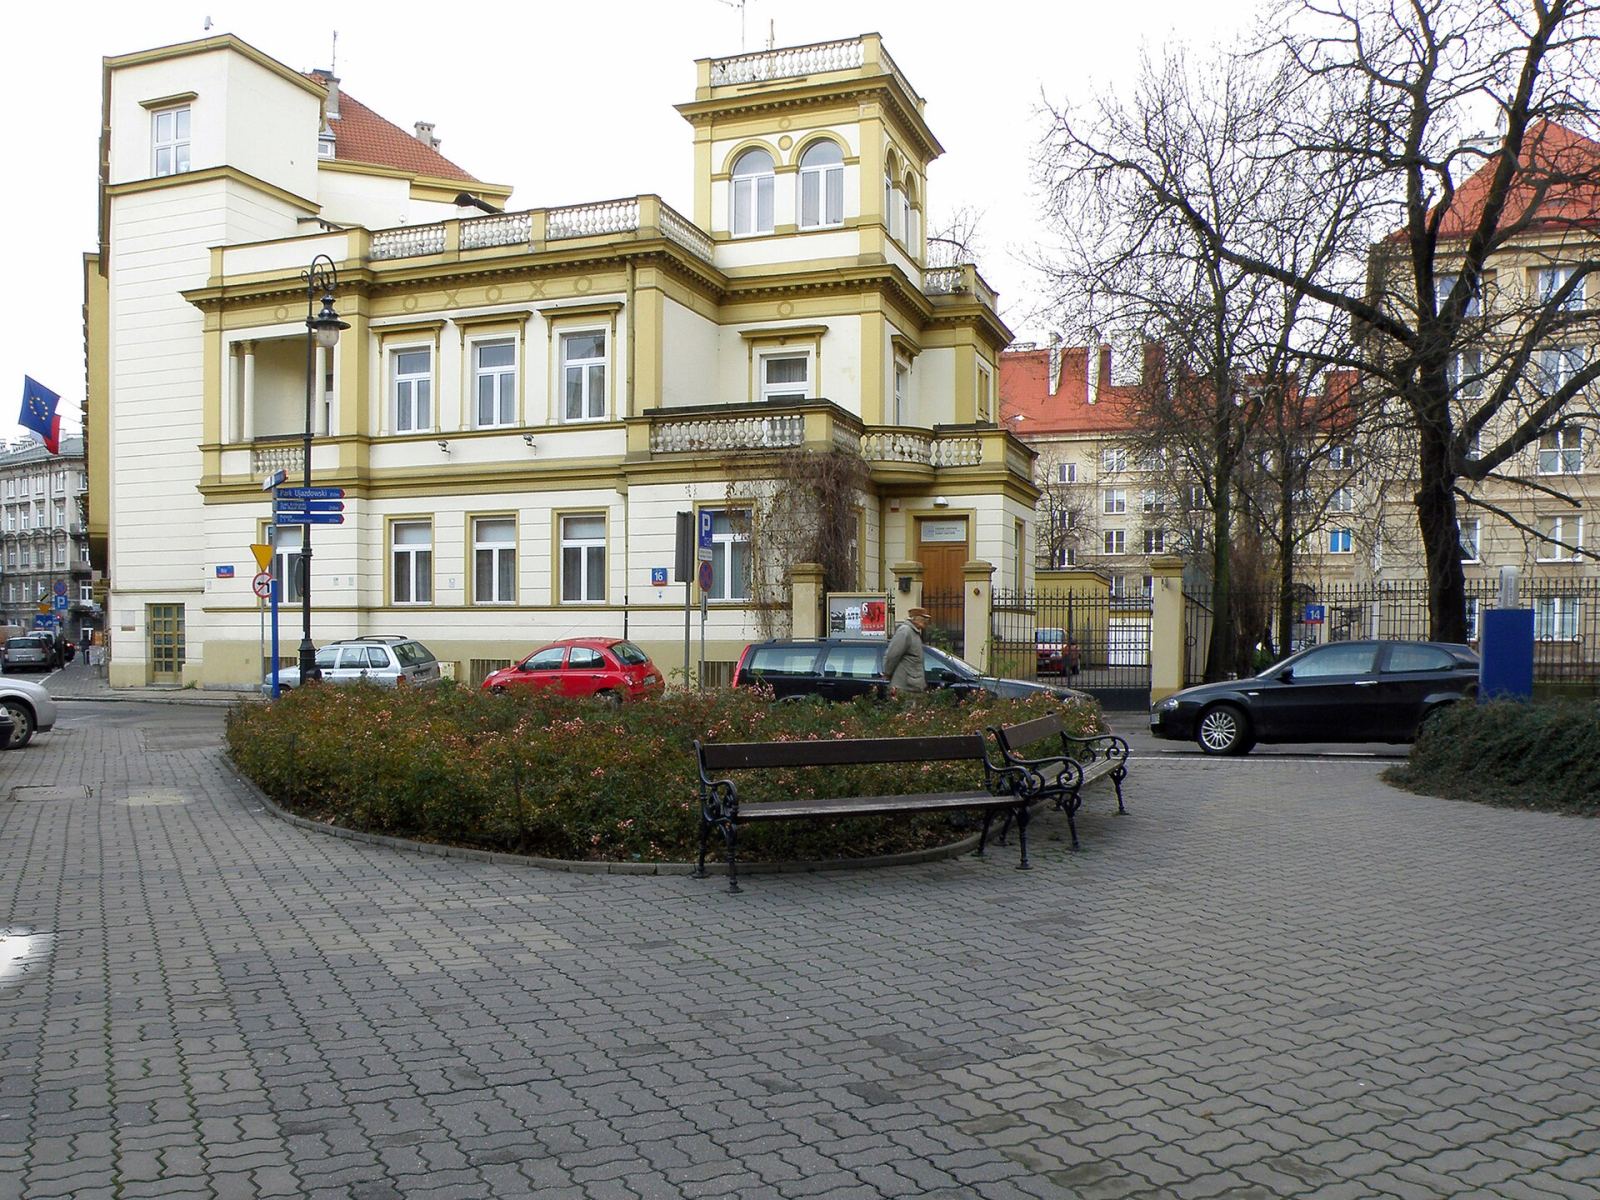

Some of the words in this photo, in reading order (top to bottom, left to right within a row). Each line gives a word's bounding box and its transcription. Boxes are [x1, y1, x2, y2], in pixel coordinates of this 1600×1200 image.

[294, 489, 328, 498] Ujazdowski
[702, 513, 711, 537] P
[654, 571, 663, 581] 16
[57, 596, 65, 609] P
[1310, 609, 1320, 620] 14
